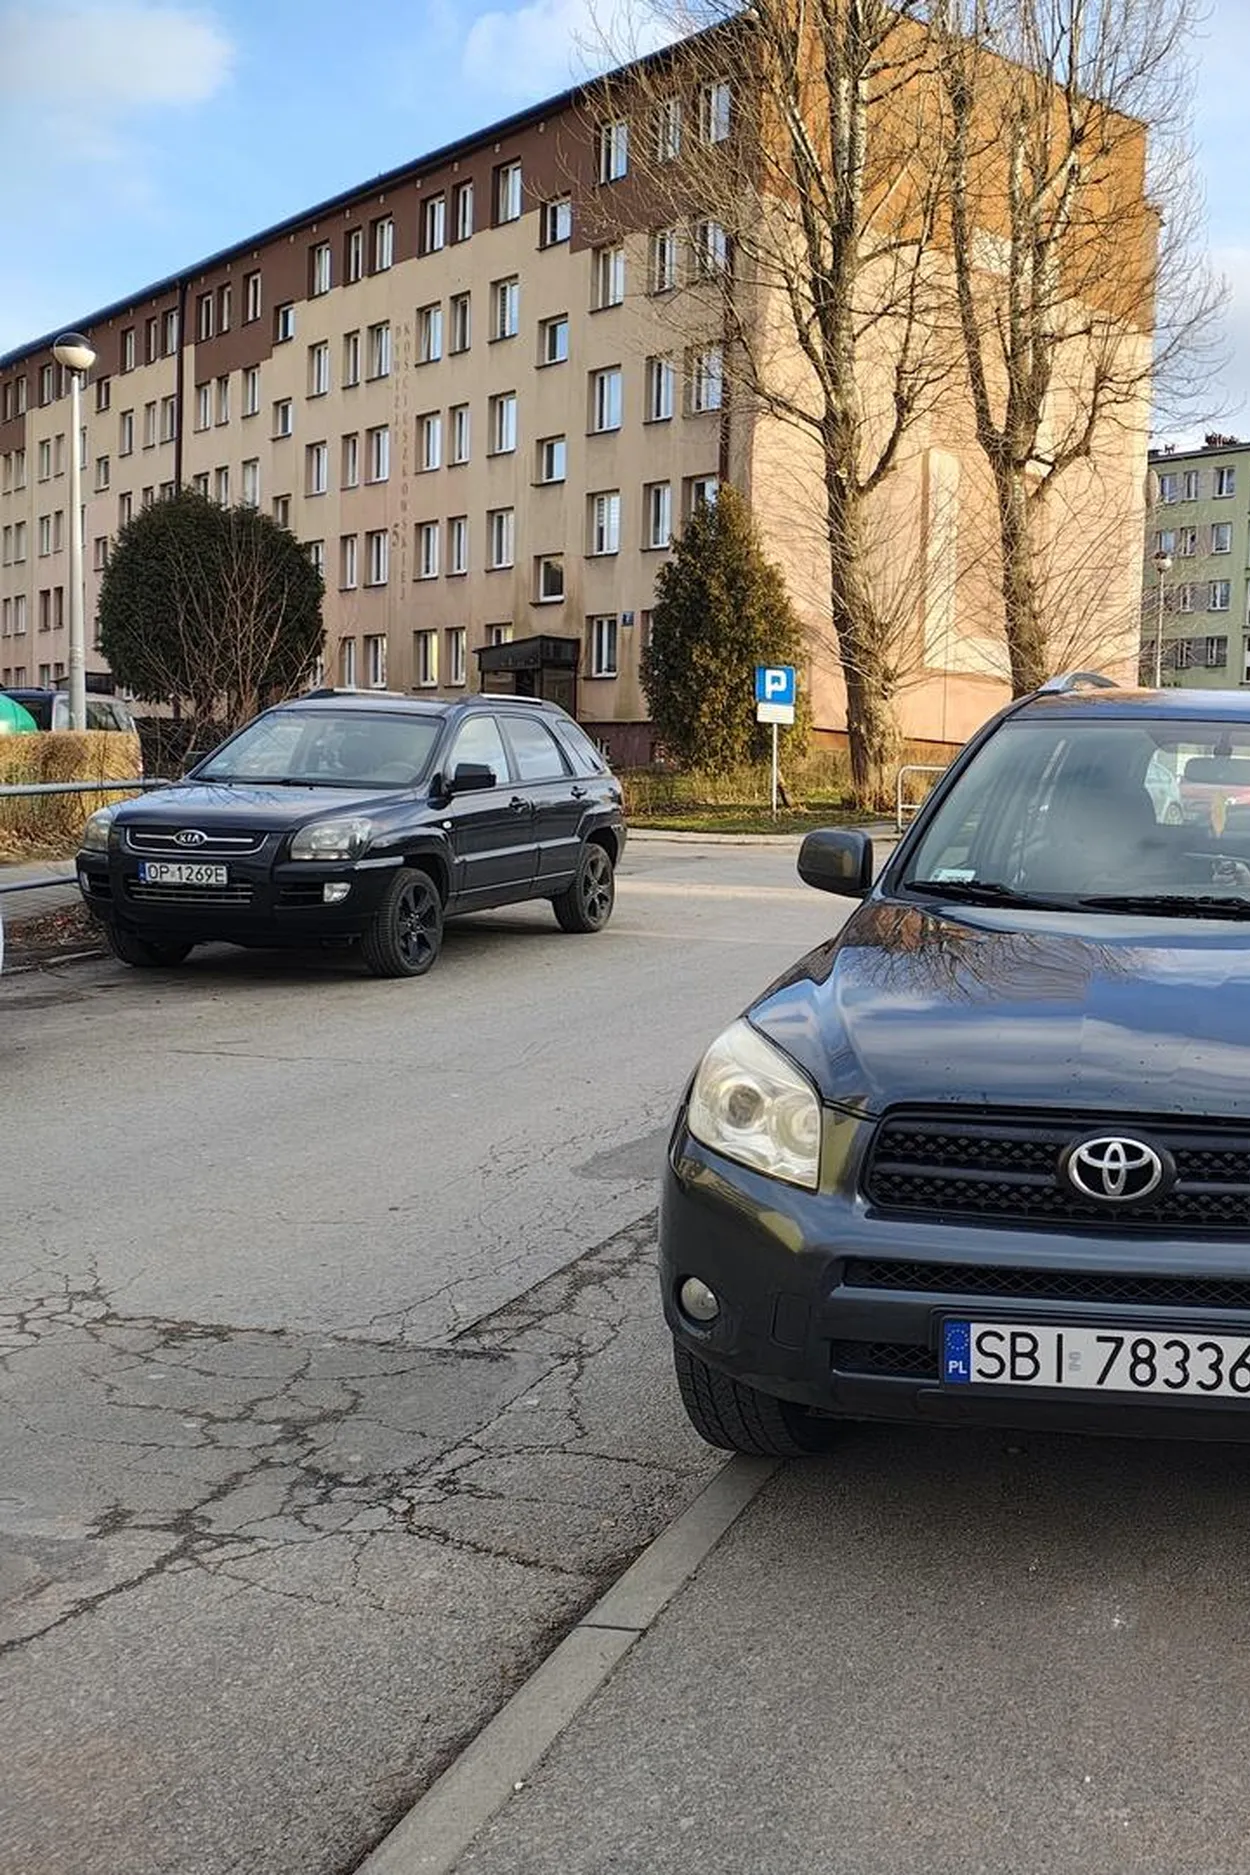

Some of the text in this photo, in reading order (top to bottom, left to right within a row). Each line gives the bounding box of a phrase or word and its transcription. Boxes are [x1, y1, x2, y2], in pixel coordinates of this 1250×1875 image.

[765, 669, 787, 699] P
[179, 833, 201, 844] KIA
[147, 864, 170, 880] OP
[177, 866, 224, 883] 1269E
[975, 1330, 1064, 1383] SBI
[948, 1360, 968, 1375] PL
